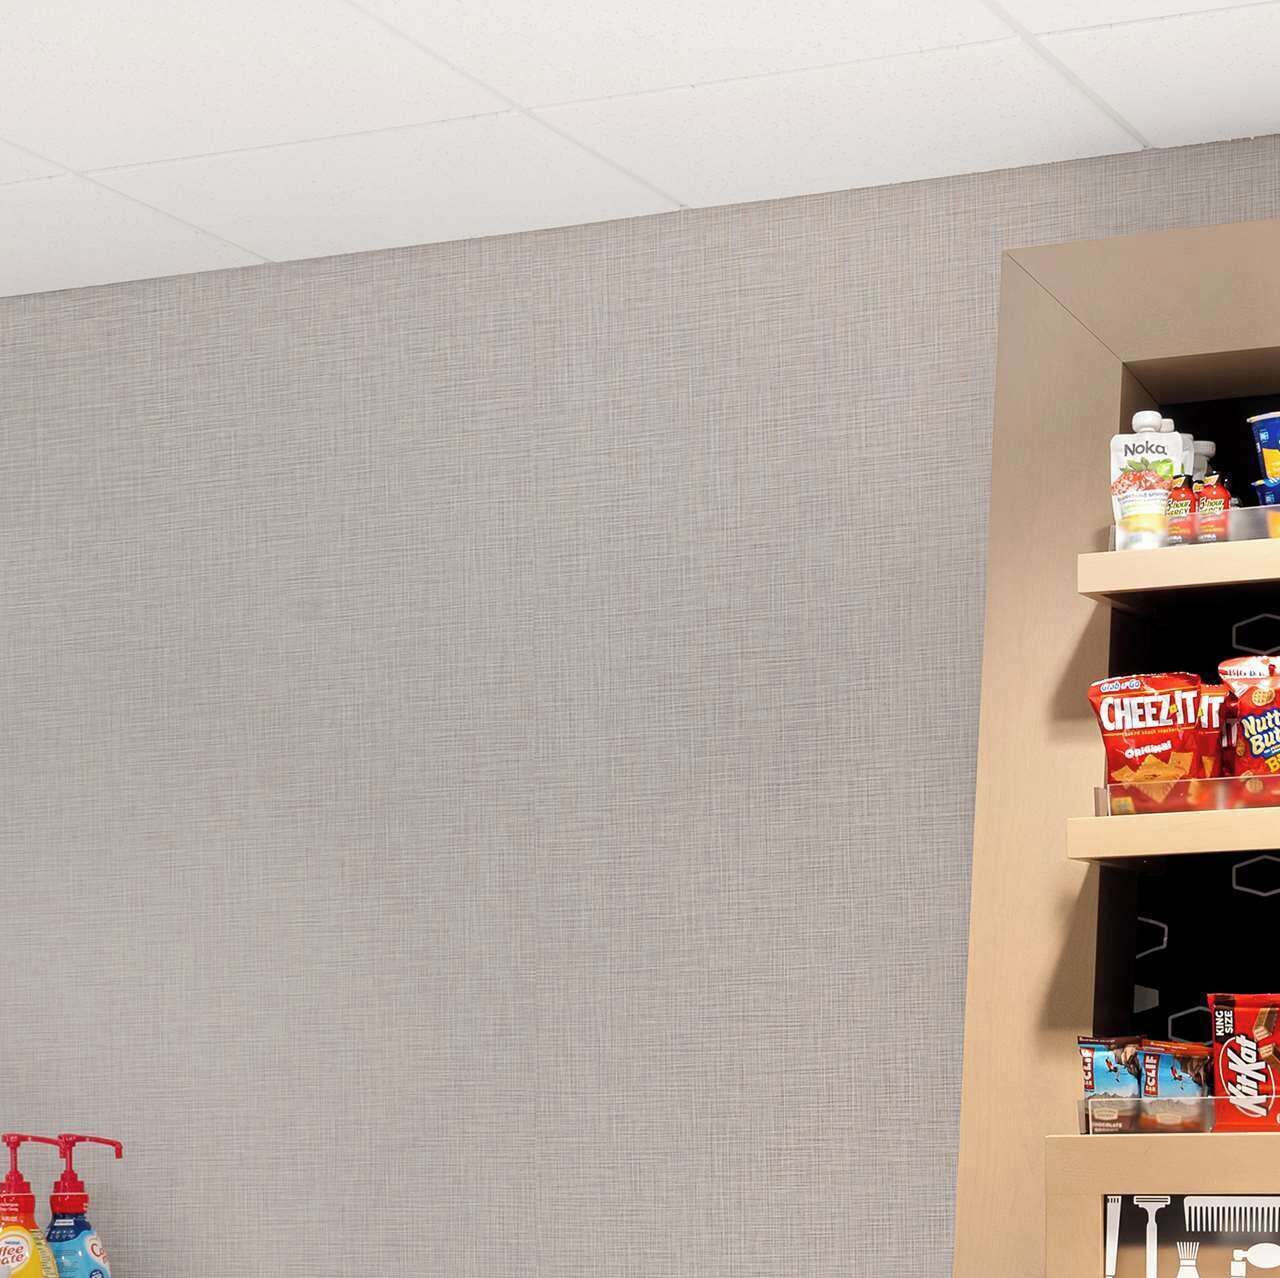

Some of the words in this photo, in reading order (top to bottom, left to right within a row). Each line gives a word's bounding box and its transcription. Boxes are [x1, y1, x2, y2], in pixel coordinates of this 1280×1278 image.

[1123, 440, 1168, 457] Noka
[1215, 1010, 1225, 1037] KING
[1225, 1009, 1233, 1034] SIZE
